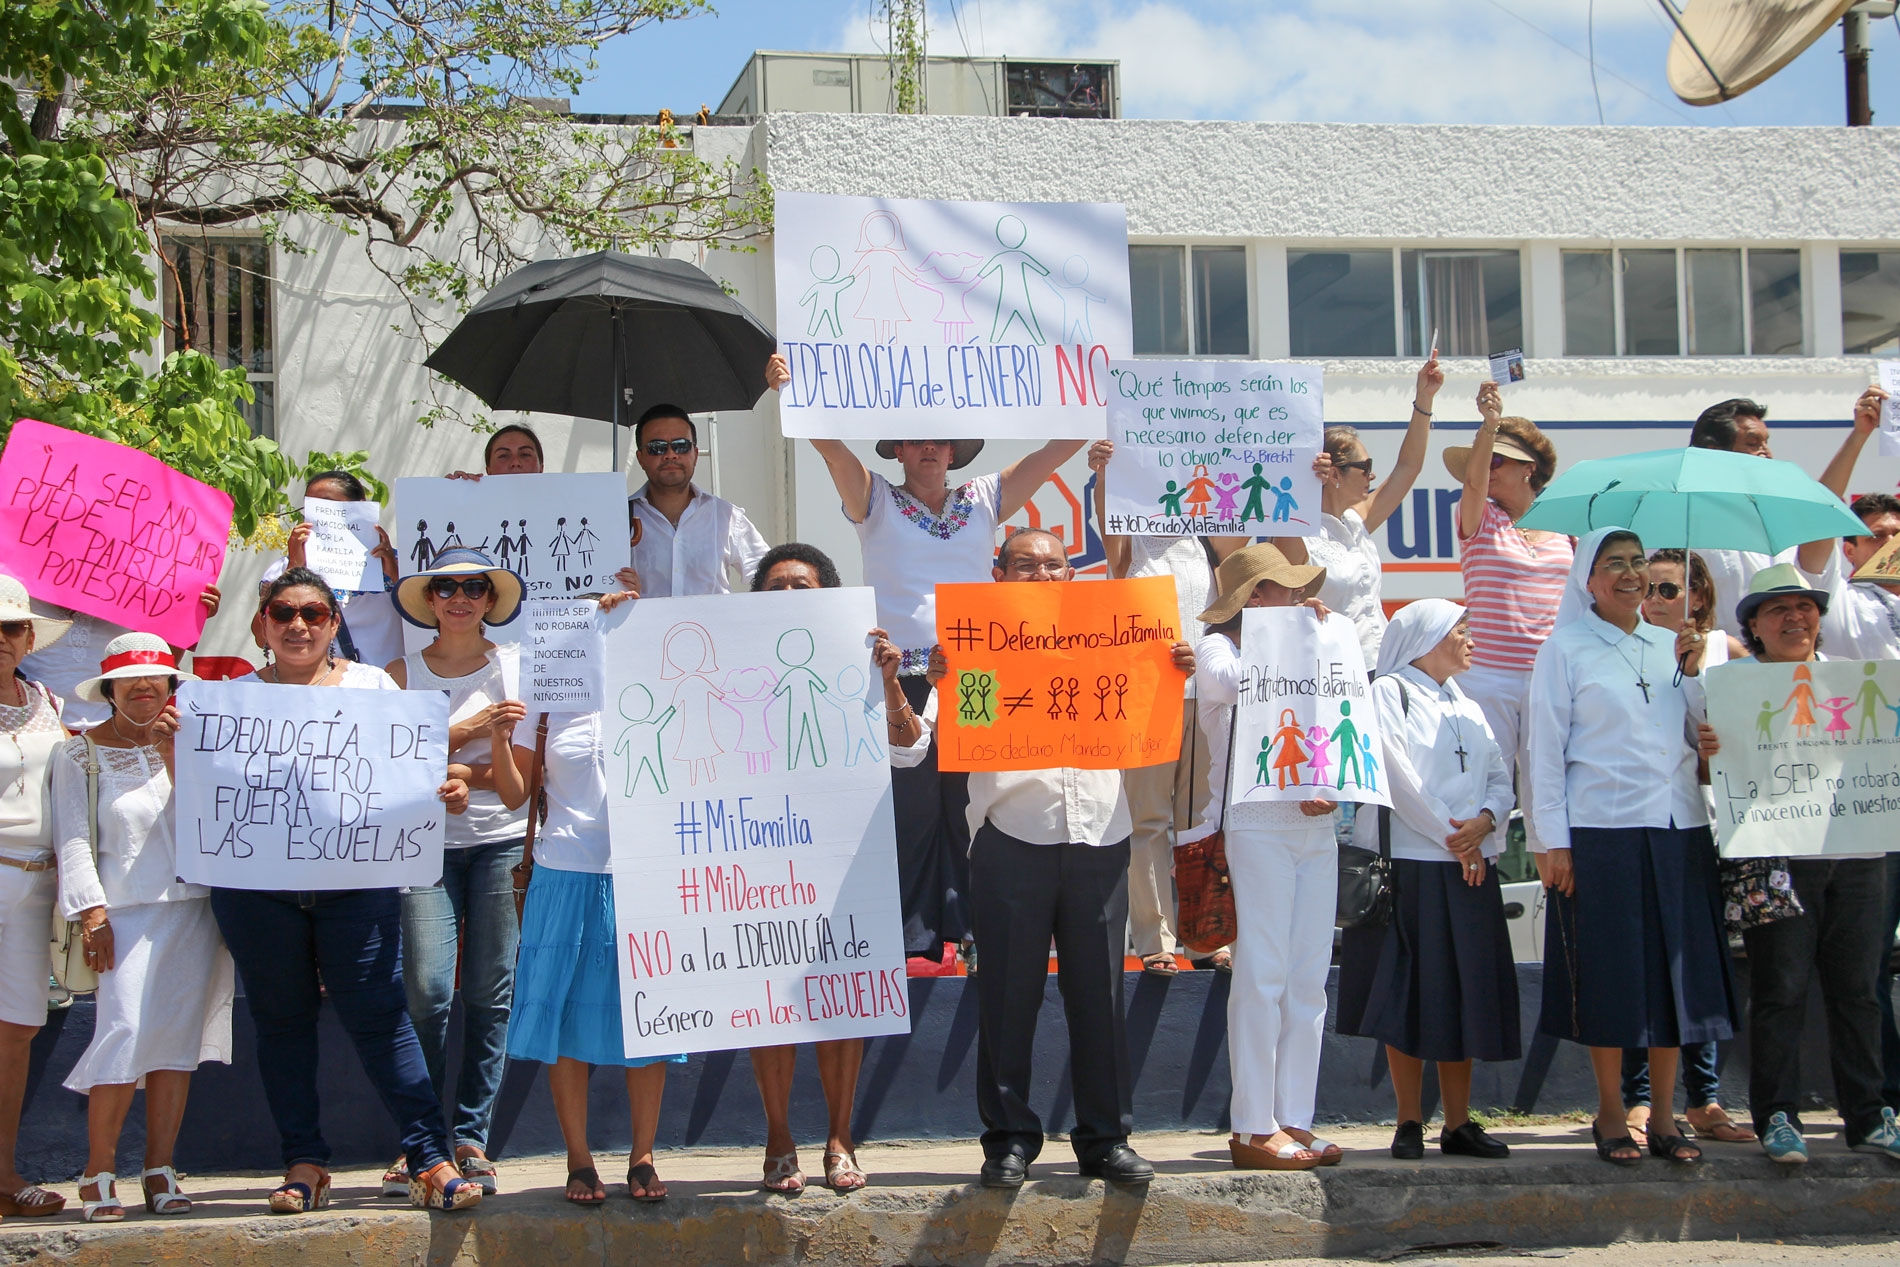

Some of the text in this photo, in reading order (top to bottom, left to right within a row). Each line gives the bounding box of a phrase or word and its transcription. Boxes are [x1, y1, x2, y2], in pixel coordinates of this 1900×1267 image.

[783, 336, 1109, 409] IDEOLOGÍA de GÉNERO NO
[1172, 371, 1232, 399] tiempos
[1240, 375, 1283, 392] serán
[1290, 377, 1308, 394] los
[1142, 406, 1289, 425] que vivimos, que es
[1125, 426, 1297, 445] necesario defender
[1159, 450, 1174, 467] lo
[102, 473, 151, 512] SEP
[159, 501, 197, 536] NO
[315, 506, 347, 518] FRENTE
[10, 477, 221, 575] PUEDE VIOLAR
[315, 532, 332, 541] POR
[316, 519, 361, 531] NACIONAL
[19, 511, 177, 590] LA PATRIA
[316, 545, 354, 555] FAMILIA
[525, 574, 615, 592] ESTO NO ES
[534, 621, 590, 631] NO ROBARA
[572, 607, 590, 616] SEP
[534, 636, 546, 645] LA
[945, 614, 1175, 652] #DefendemosLaFamilia
[533, 649, 587, 660] INOCENCIA
[533, 663, 547, 673] DE
[533, 677, 584, 687] NUESTROS
[390, 723, 431, 760] DE
[957, 736, 997, 761] Los
[1000, 733, 1054, 760] declaro
[1117, 743, 1127, 762] y
[1130, 732, 1163, 759] Mujer
[1758, 742, 1789, 751] FRENTE
[244, 752, 373, 794] GENERO
[1770, 763, 1820, 796] SEP
[1825, 778, 1845, 791] no
[1852, 762, 1900, 789] robará
[215, 786, 383, 828] FUERA DE
[1729, 801, 1745, 825] la
[1749, 800, 1822, 823] inocencia
[1829, 793, 1846, 817] de
[198, 818, 254, 859] LAS
[674, 794, 813, 855] #MiFamilia
[677, 860, 816, 914] #MiDerecho
[628, 913, 871, 979] NO a la IDEOLOGÍA de
[634, 967, 907, 1037] Género en las ESCUELAS
